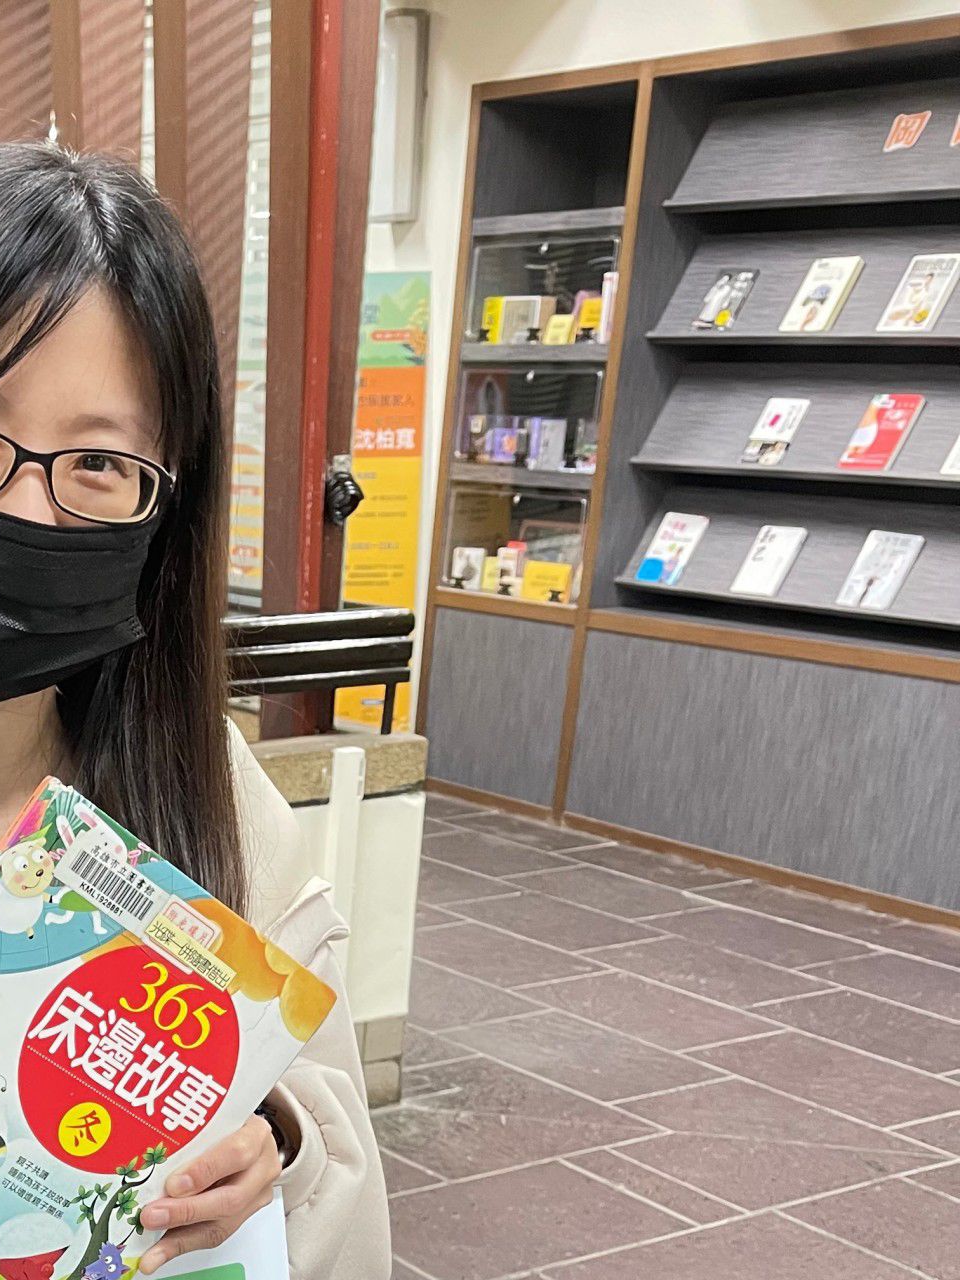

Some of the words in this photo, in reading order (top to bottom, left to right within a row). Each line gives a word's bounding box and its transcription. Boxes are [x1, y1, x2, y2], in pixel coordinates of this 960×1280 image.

[119, 961, 228, 1049] 365
[27, 986, 228, 1132] 床邊故事
[65, 1109, 102, 1148] 冬
